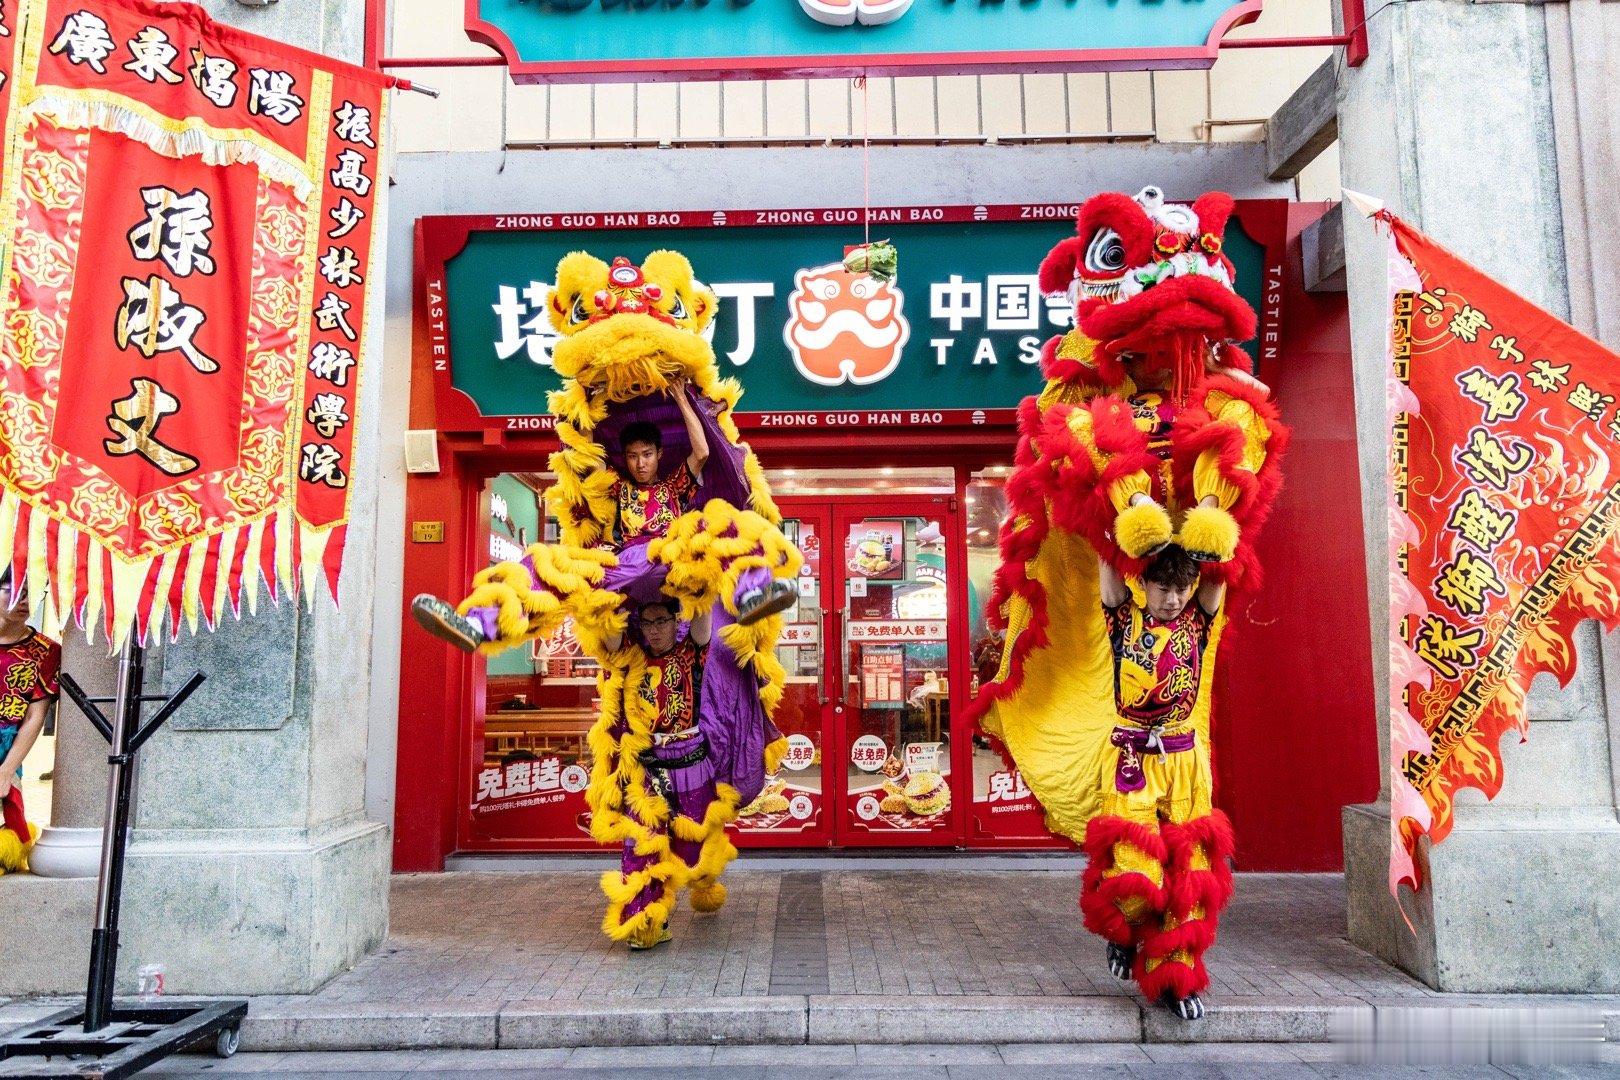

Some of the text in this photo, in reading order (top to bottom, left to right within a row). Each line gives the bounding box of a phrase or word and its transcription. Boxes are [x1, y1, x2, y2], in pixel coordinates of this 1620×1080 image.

[47, 9, 306, 126] 廣東揭陽
[495, 213, 681, 228] ZHONG GUO HAN BAO
[756, 208, 944, 223] ZHONG GUO HAN BAO
[1021, 206, 1079, 218] ZHONG
[298, 99, 377, 490] 振高少林武術學院
[930, 274, 1079, 331] 中国
[1265, 265, 1282, 358] TASTIEN
[429, 280, 447, 372] TASTIEN
[761, 412, 943, 426] ZHONG GUO HAN BAO
[1412, 366, 1535, 680] 喜悅醒獅隊
[867, 625, 926, 636] 免费单人餐
[853, 748, 886, 760] 送免费
[476, 757, 560, 801] 免费送
